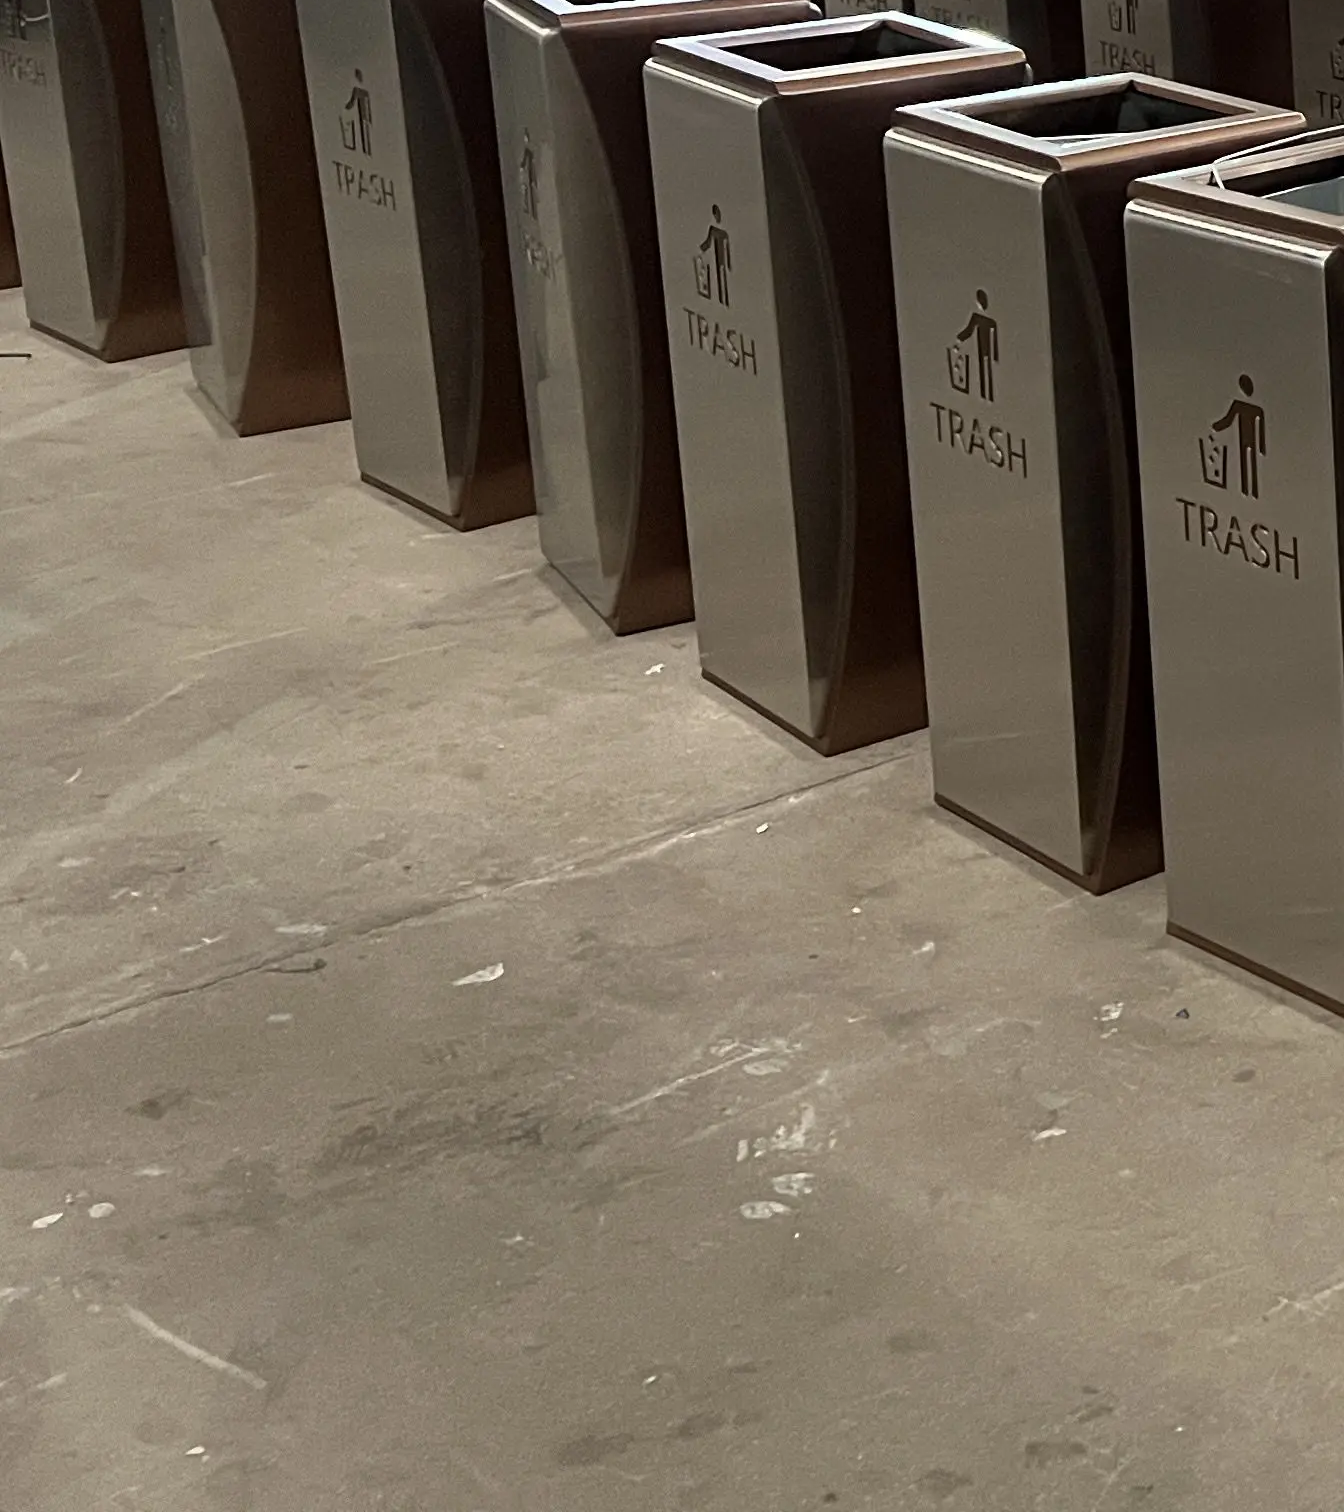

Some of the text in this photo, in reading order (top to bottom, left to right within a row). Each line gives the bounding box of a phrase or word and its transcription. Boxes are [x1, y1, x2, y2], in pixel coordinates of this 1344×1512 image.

[332, 160, 397, 211] TRASH
[683, 306, 758, 376] TRASH
[929, 401, 1028, 479] TRASH
[1175, 496, 1301, 580] TRASH
